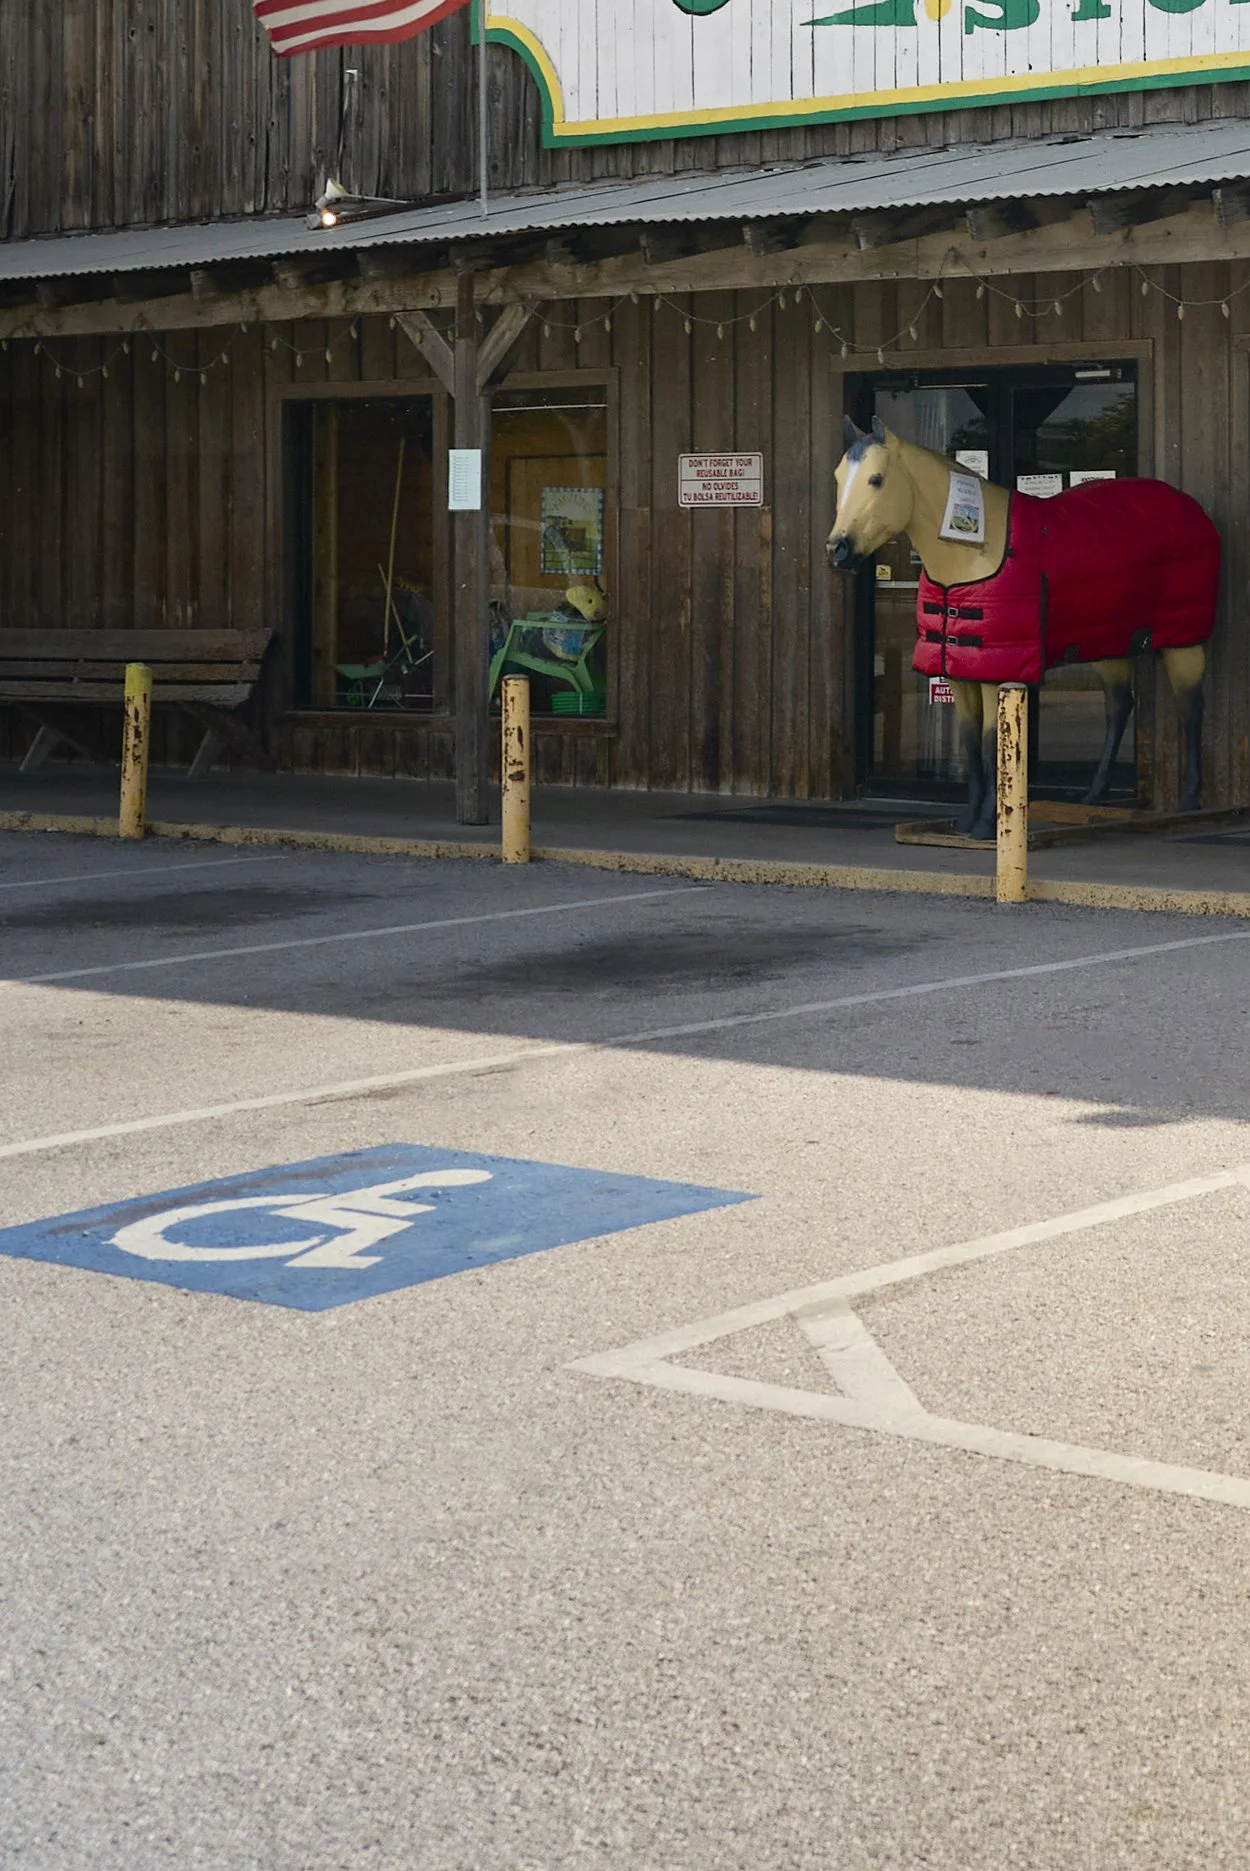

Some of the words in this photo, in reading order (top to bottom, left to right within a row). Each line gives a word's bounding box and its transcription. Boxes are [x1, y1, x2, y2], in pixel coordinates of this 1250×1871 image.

[709, 458, 733, 467] FORGET
[735, 458, 752, 467] YOUR
[696, 469, 727, 478] REUSABLE
[702, 482, 711, 490] NO
